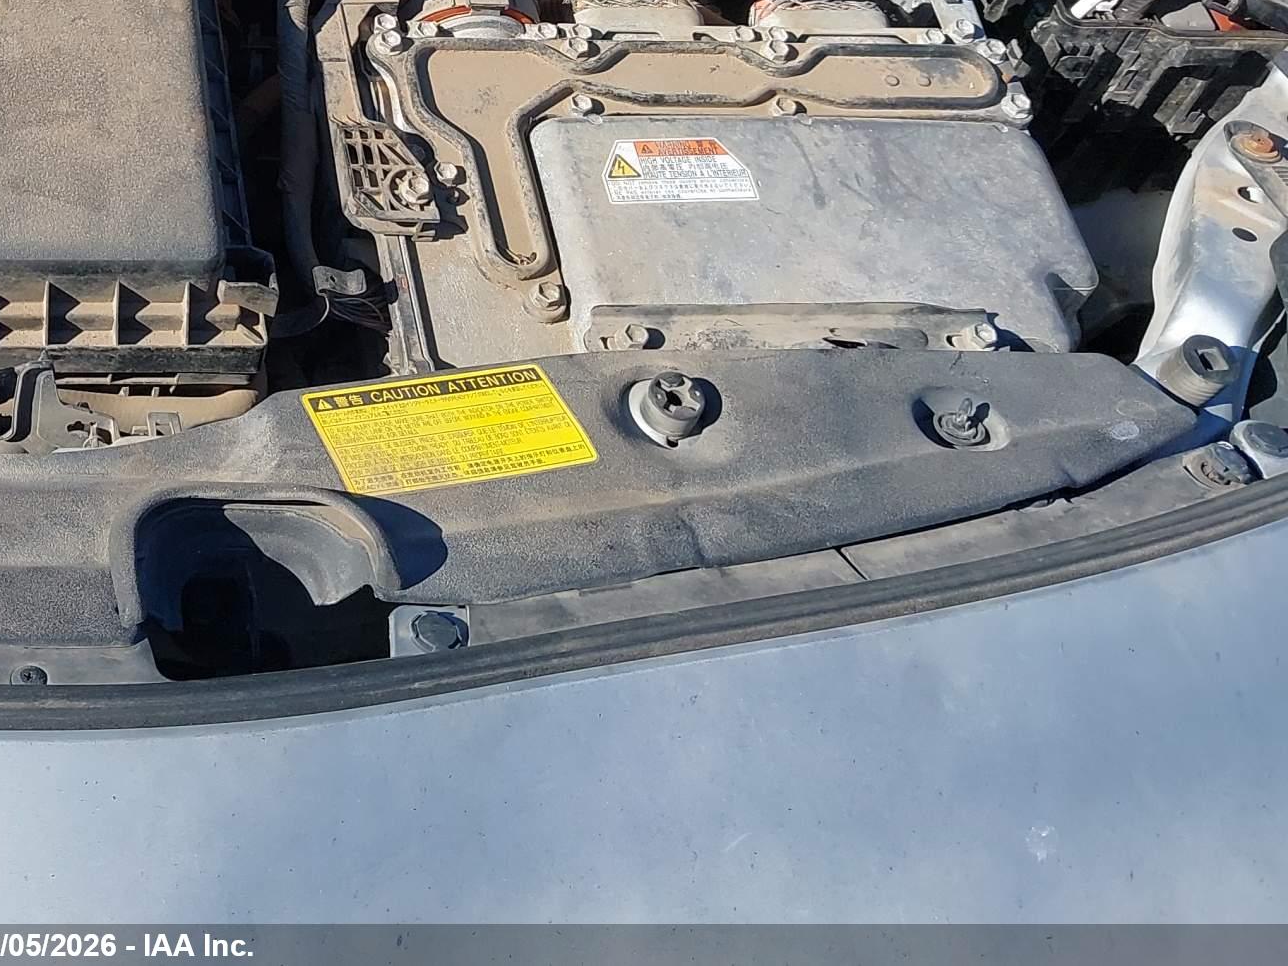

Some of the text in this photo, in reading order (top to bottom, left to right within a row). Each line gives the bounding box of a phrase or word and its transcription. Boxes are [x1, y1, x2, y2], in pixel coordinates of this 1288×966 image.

[640, 156, 658, 164] HIGH
[660, 156, 691, 164] VOLTAGE
[668, 170, 698, 178] TENSION
[334, 370, 537, 408] 警告 CAUTION ATTENTION
